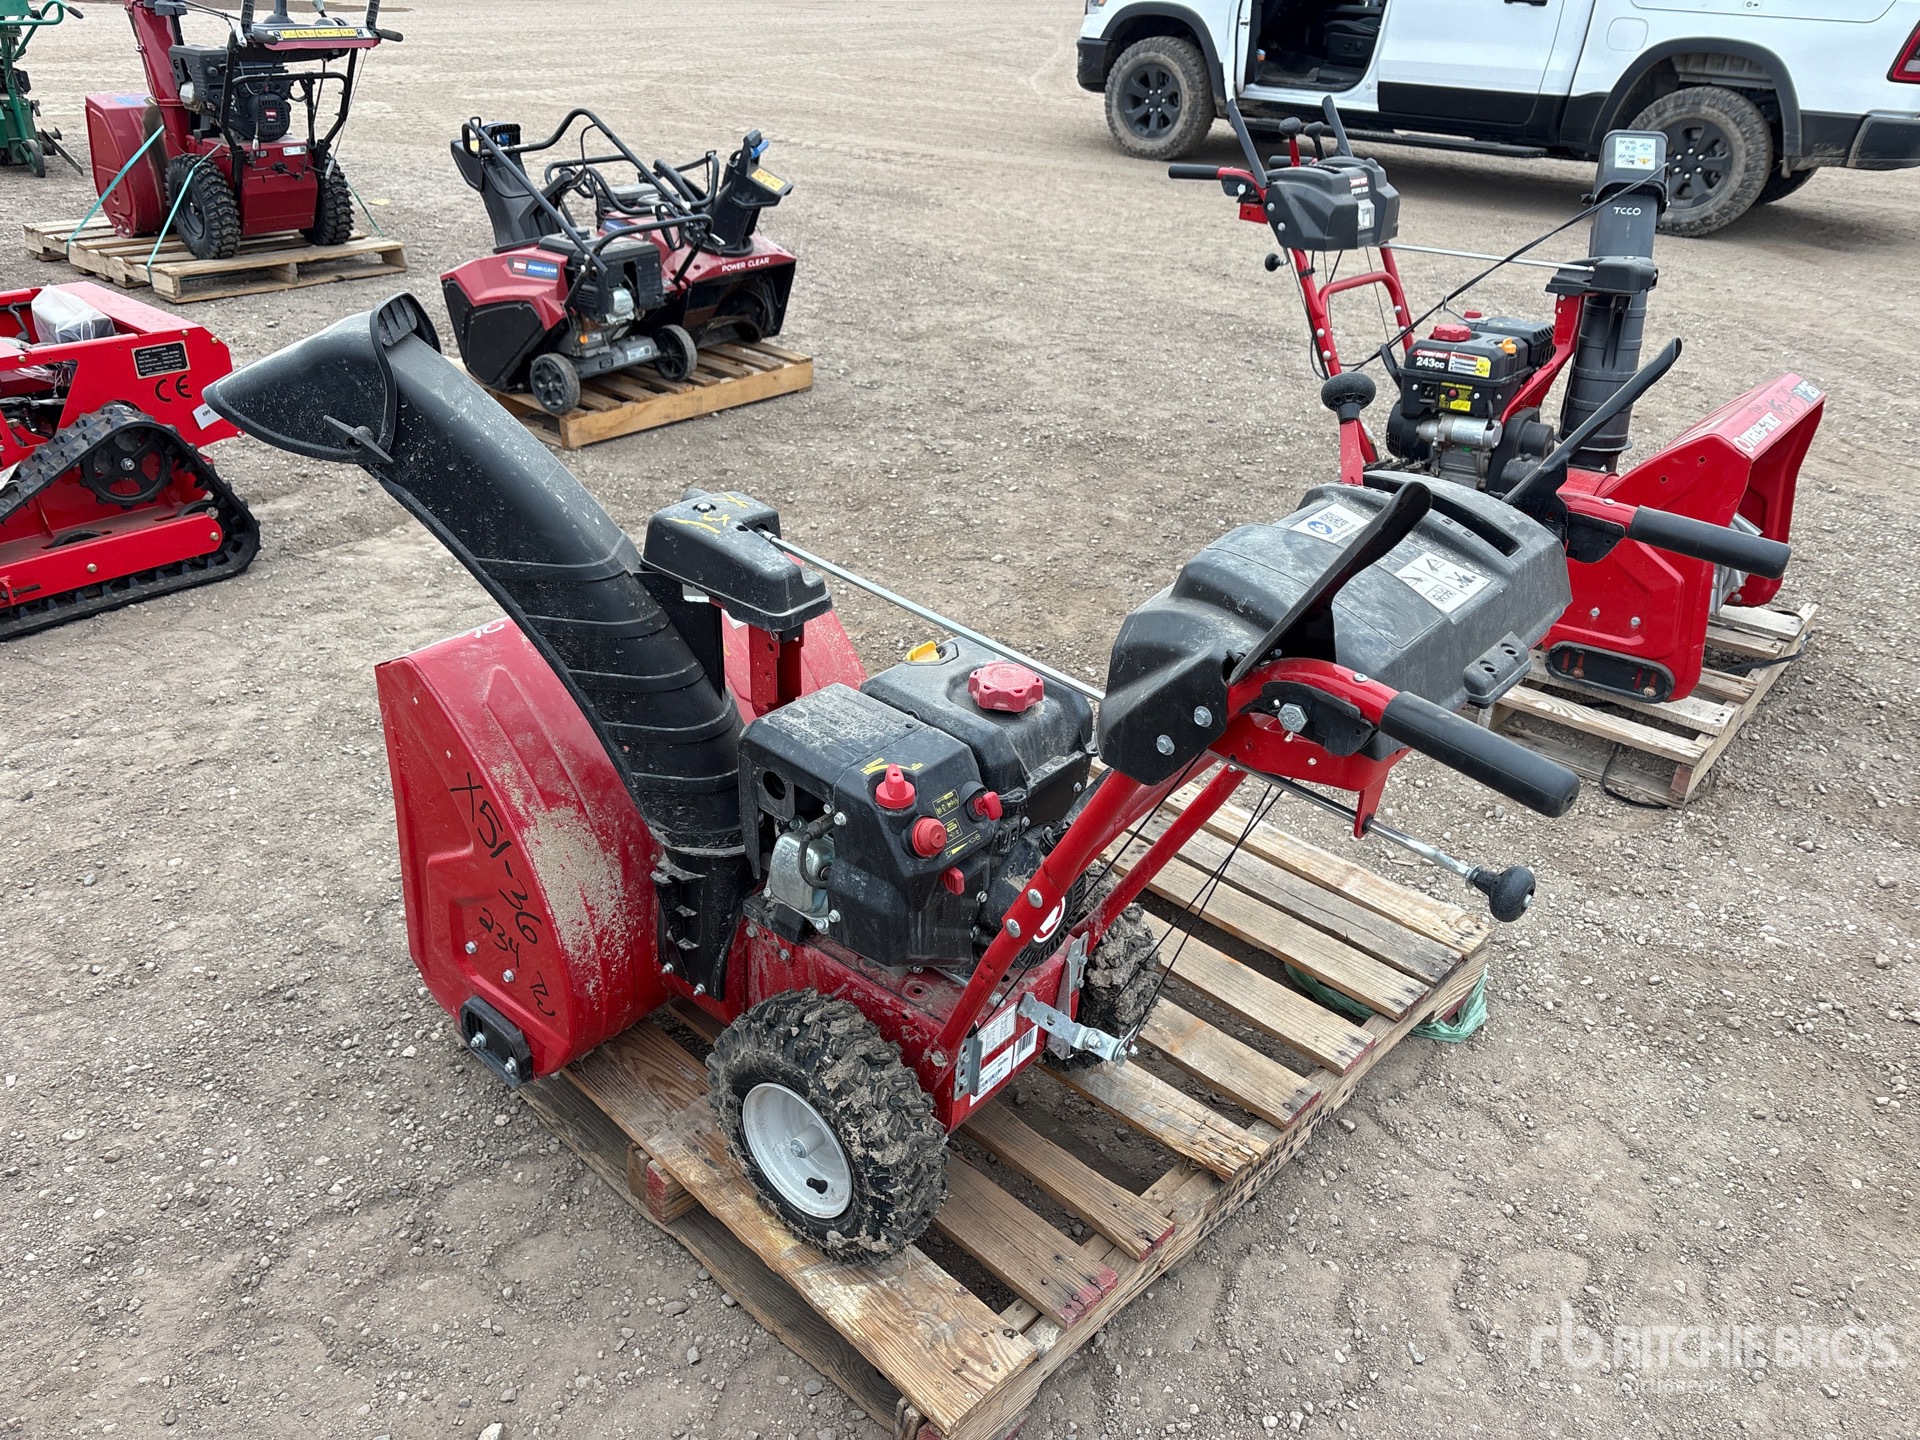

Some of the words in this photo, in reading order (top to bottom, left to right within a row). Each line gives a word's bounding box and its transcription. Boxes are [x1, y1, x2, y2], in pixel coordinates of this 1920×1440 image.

[721, 261, 746, 272] POWER
[747, 257, 770, 268] CLEAR
[1416, 356, 1446, 369] 243cc
